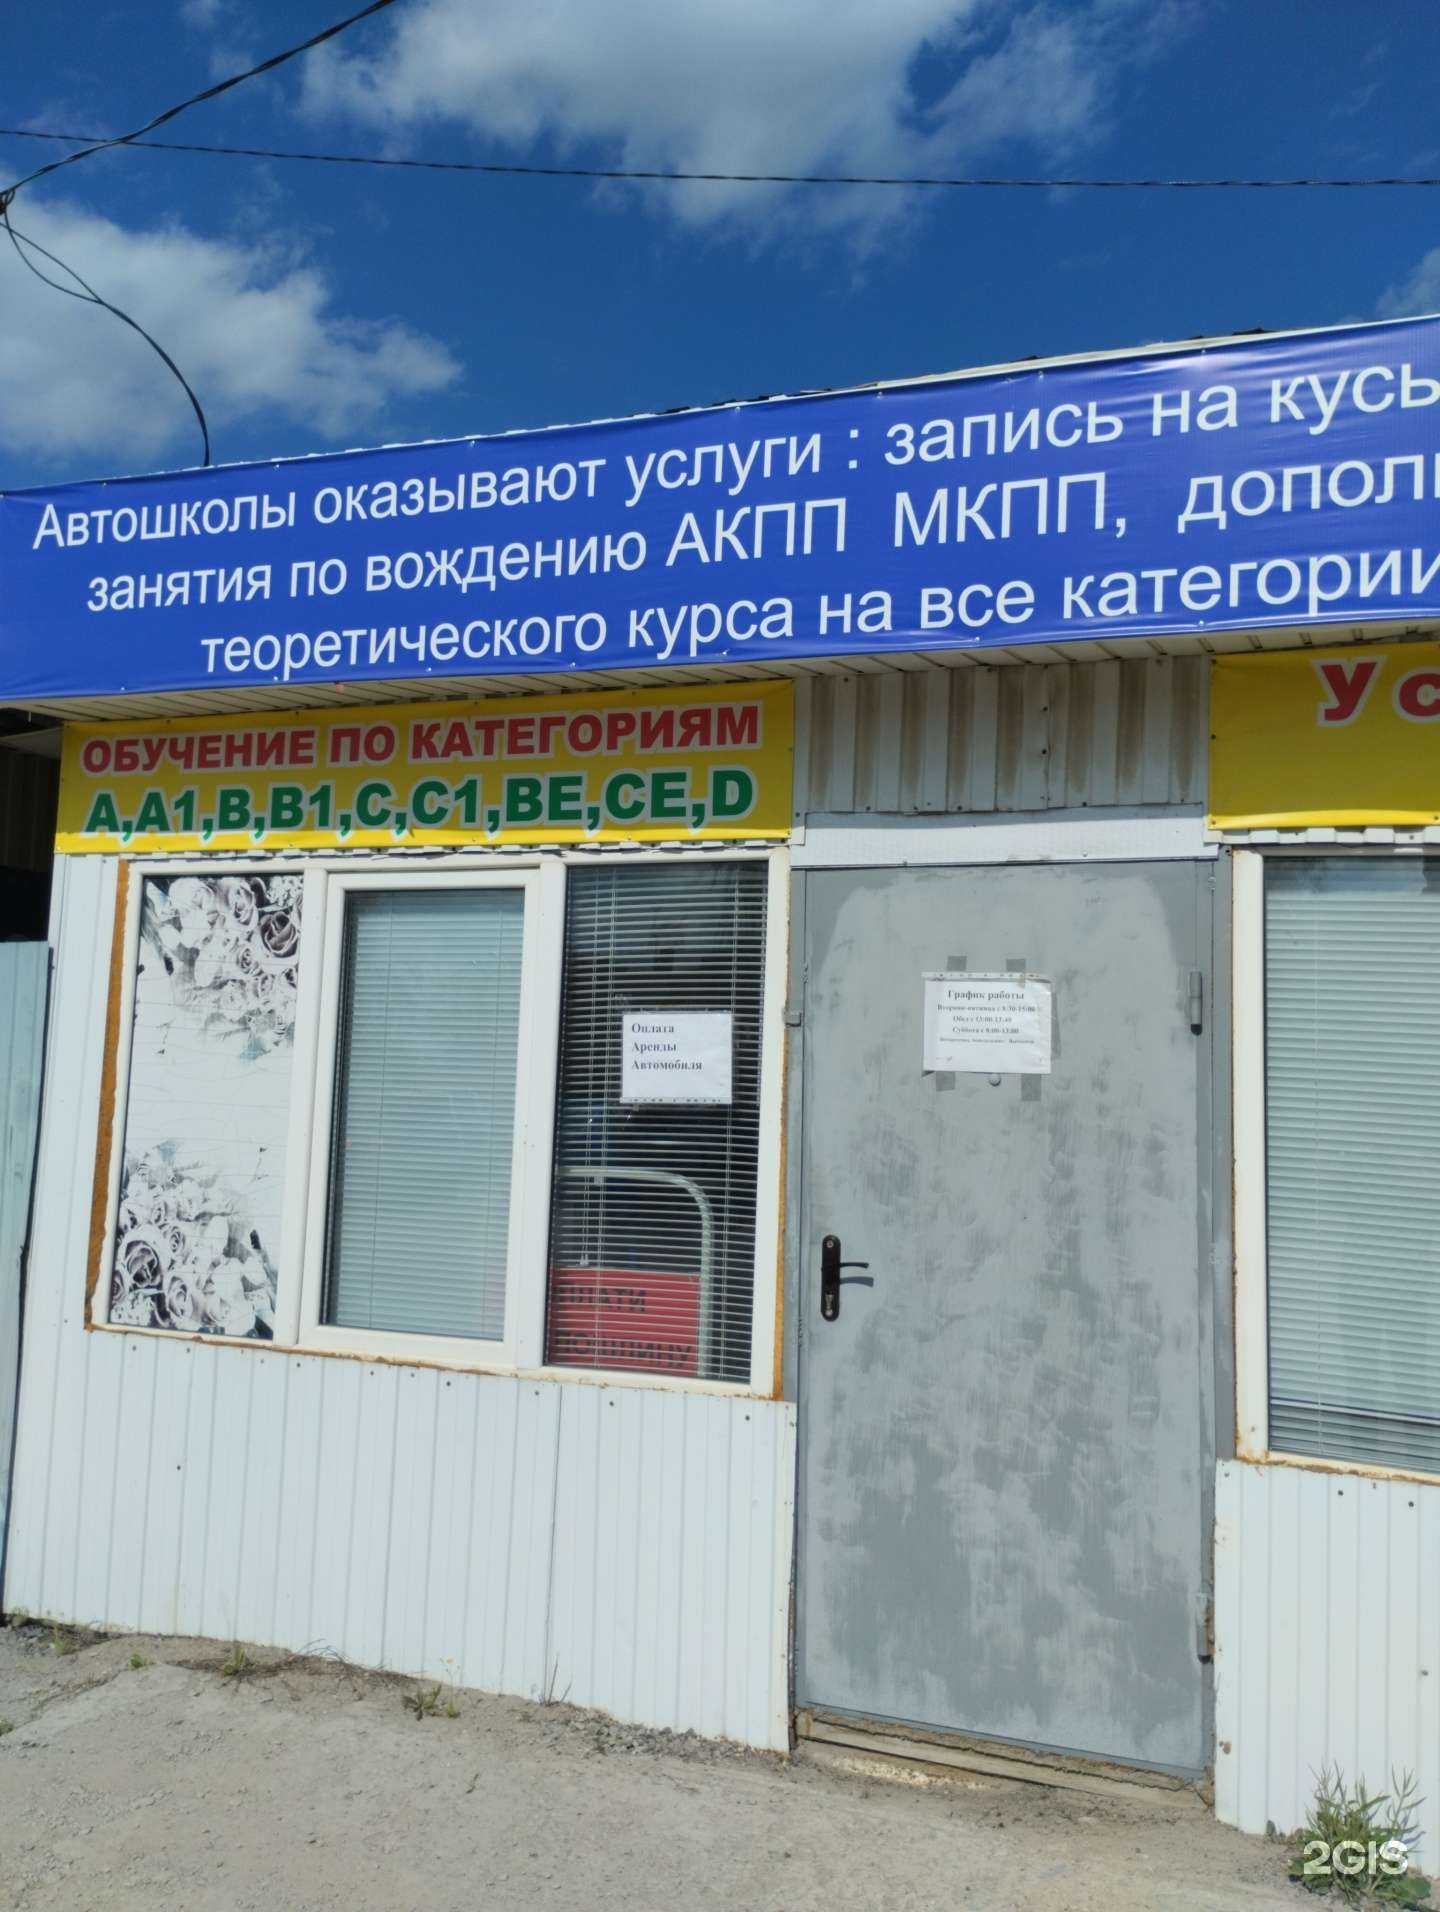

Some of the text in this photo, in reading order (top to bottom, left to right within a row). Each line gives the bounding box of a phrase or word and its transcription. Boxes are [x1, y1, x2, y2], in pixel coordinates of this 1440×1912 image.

[32, 492, 296, 549] Автошколы
[312, 458, 606, 524] оказывают
[625, 433, 821, 507] услуги
[884, 401, 1124, 465] запись
[1152, 384, 1238, 436] на
[87, 452, 1440, 612] занятия по вождению АКПП МКПП, допол
[201, 612, 607, 682] теоретического
[629, 597, 793, 660] курса
[819, 590, 892, 635] на
[920, 580, 1035, 629] все
[83, 705, 759, 774] ОБУЧЕНИЕ ПО КАТЕГОРИЯМ
[948, 989, 1024, 1001] График работы
[631, 1023, 675, 1034] Оплата
[631, 1042, 677, 1053] Аренды
[631, 1060, 703, 1070] Автомобиля
